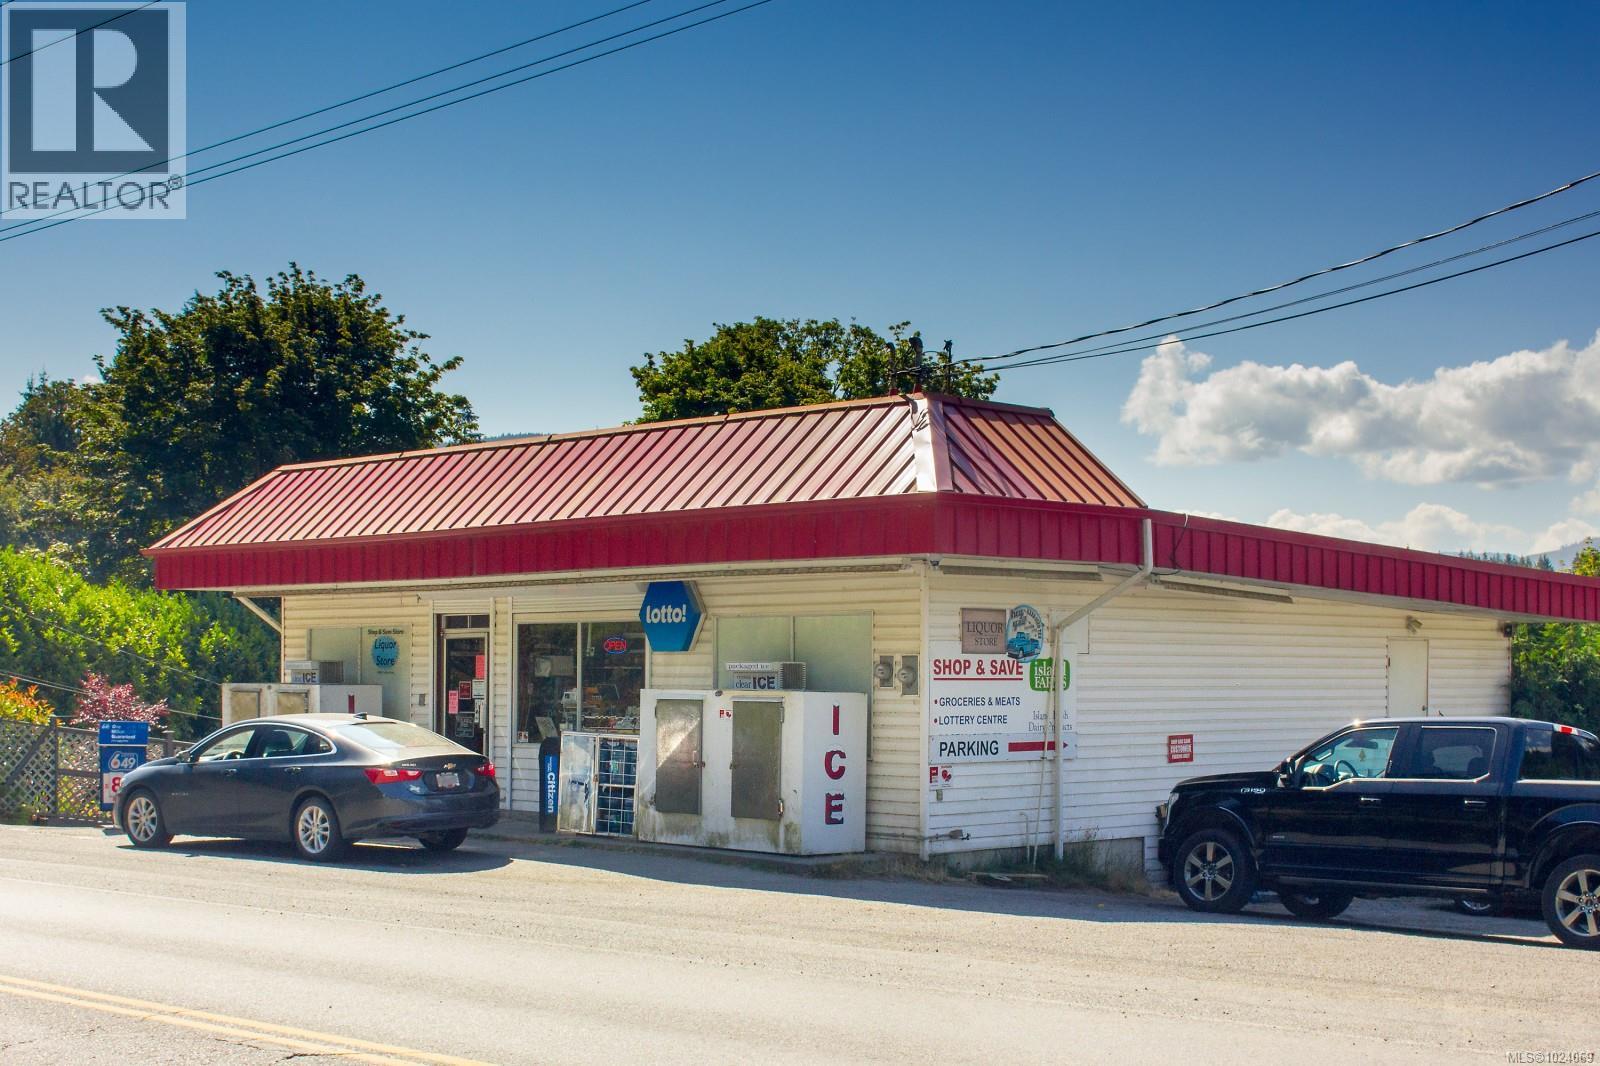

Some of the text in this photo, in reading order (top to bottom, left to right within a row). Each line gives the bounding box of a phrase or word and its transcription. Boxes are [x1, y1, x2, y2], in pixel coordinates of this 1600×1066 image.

[645, 604, 687, 624] lotto!
[966, 621, 1004, 634] LIQUOR
[374, 638, 396, 651] Liquor
[604, 640, 626, 651] OPEN
[974, 637, 998, 646] STORE
[375, 656, 395, 667] Store
[933, 659, 1023, 676] SHOP & SAVE
[302, 672, 316, 683] ICE
[752, 675, 776, 689] ICE
[939, 696, 1021, 707] GROCERIES & MEATS
[938, 714, 1008, 726] LOTTERY CENTRE
[939, 740, 999, 757] PARKING
[547, 772, 556, 813] Citizen
